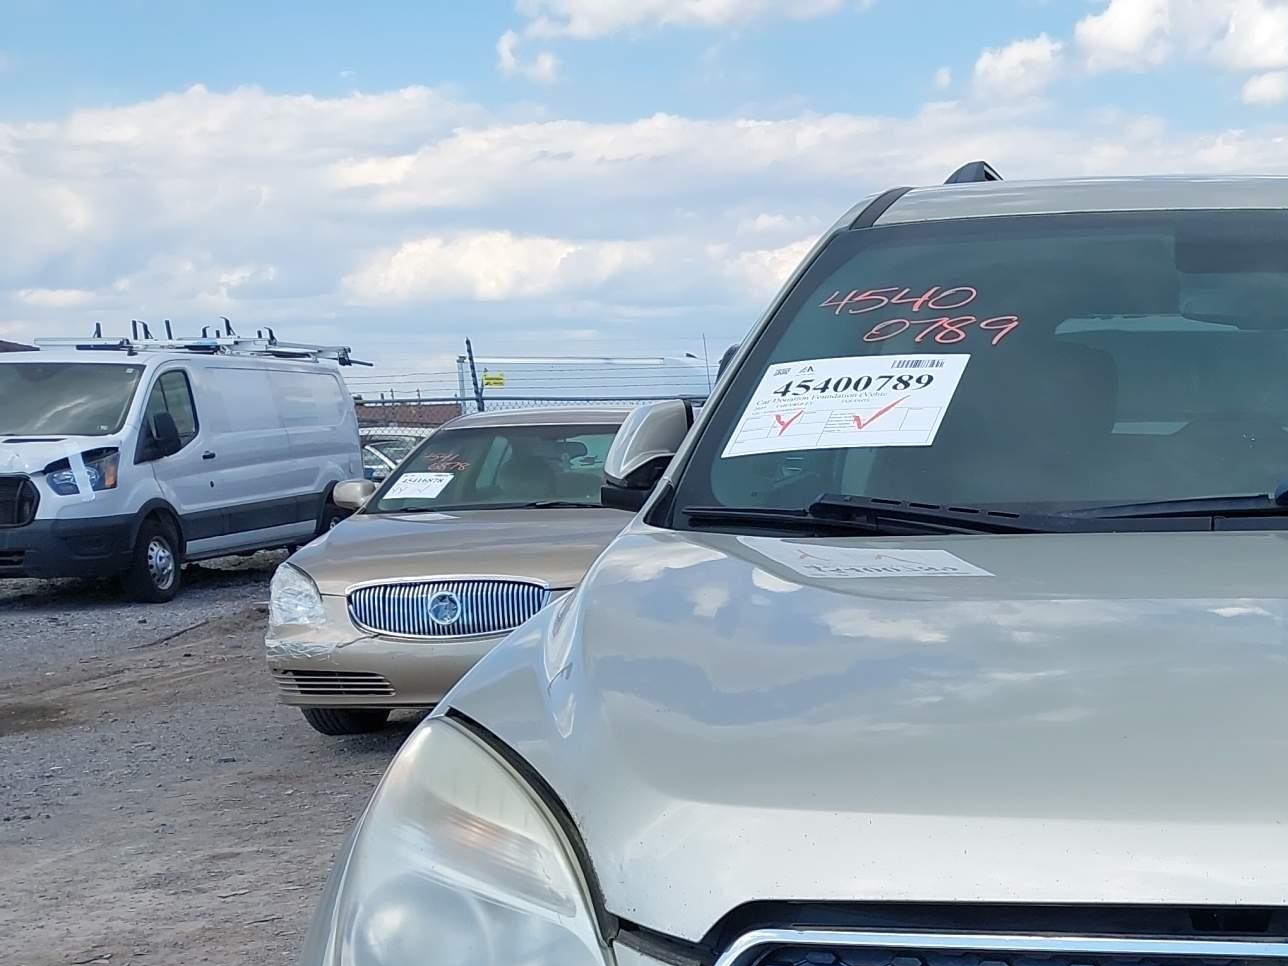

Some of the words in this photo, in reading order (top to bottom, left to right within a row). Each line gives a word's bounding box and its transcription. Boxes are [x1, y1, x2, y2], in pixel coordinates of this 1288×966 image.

[819, 286, 977, 315] 4540
[863, 315, 1020, 345] 0789
[773, 374, 934, 398] 45400789
